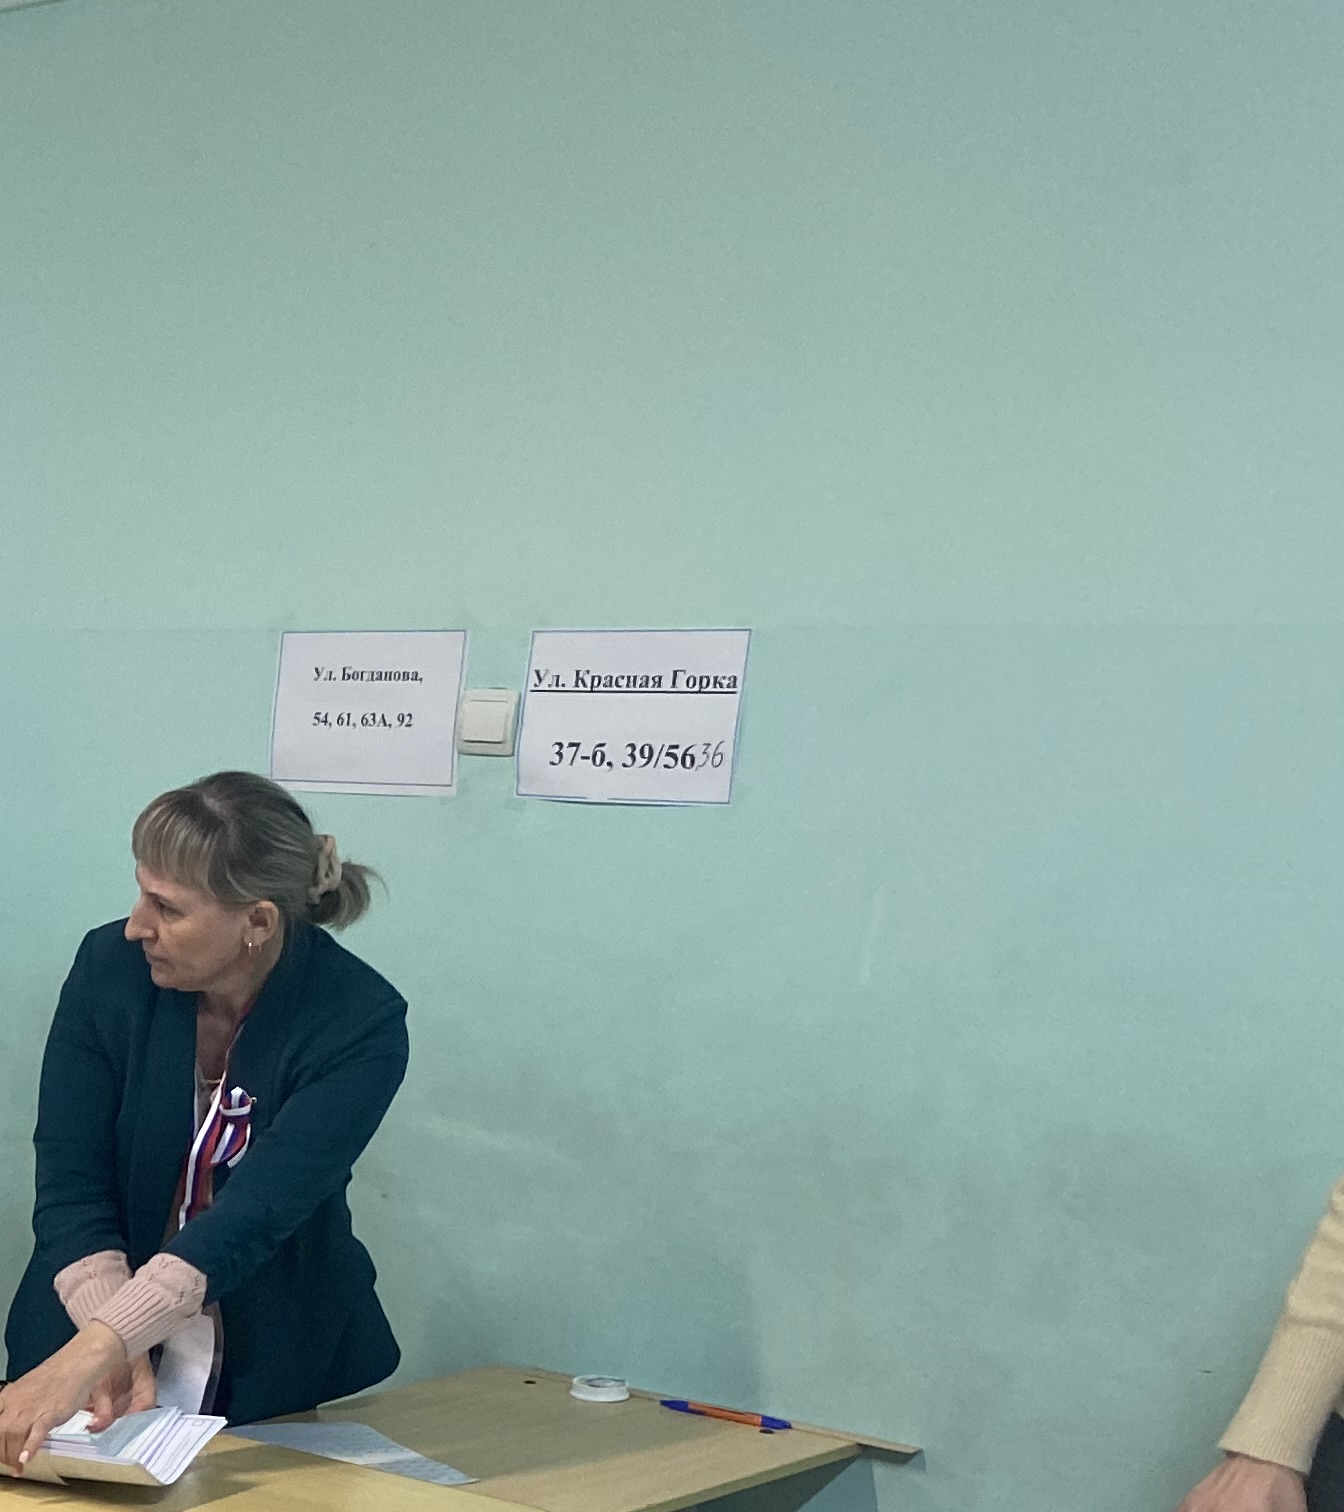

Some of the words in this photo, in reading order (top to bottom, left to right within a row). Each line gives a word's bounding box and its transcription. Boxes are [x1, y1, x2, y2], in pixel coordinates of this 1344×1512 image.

[313, 667, 336, 682] Ул.
[341, 666, 423, 683] Богданова,
[533, 669, 566, 688] Ул.
[573, 669, 663, 691] Красная
[670, 669, 738, 692] Горка
[312, 712, 333, 728] 54,
[336, 712, 357, 729] 61,
[360, 712, 392, 729] 63А,
[396, 713, 413, 728] 92
